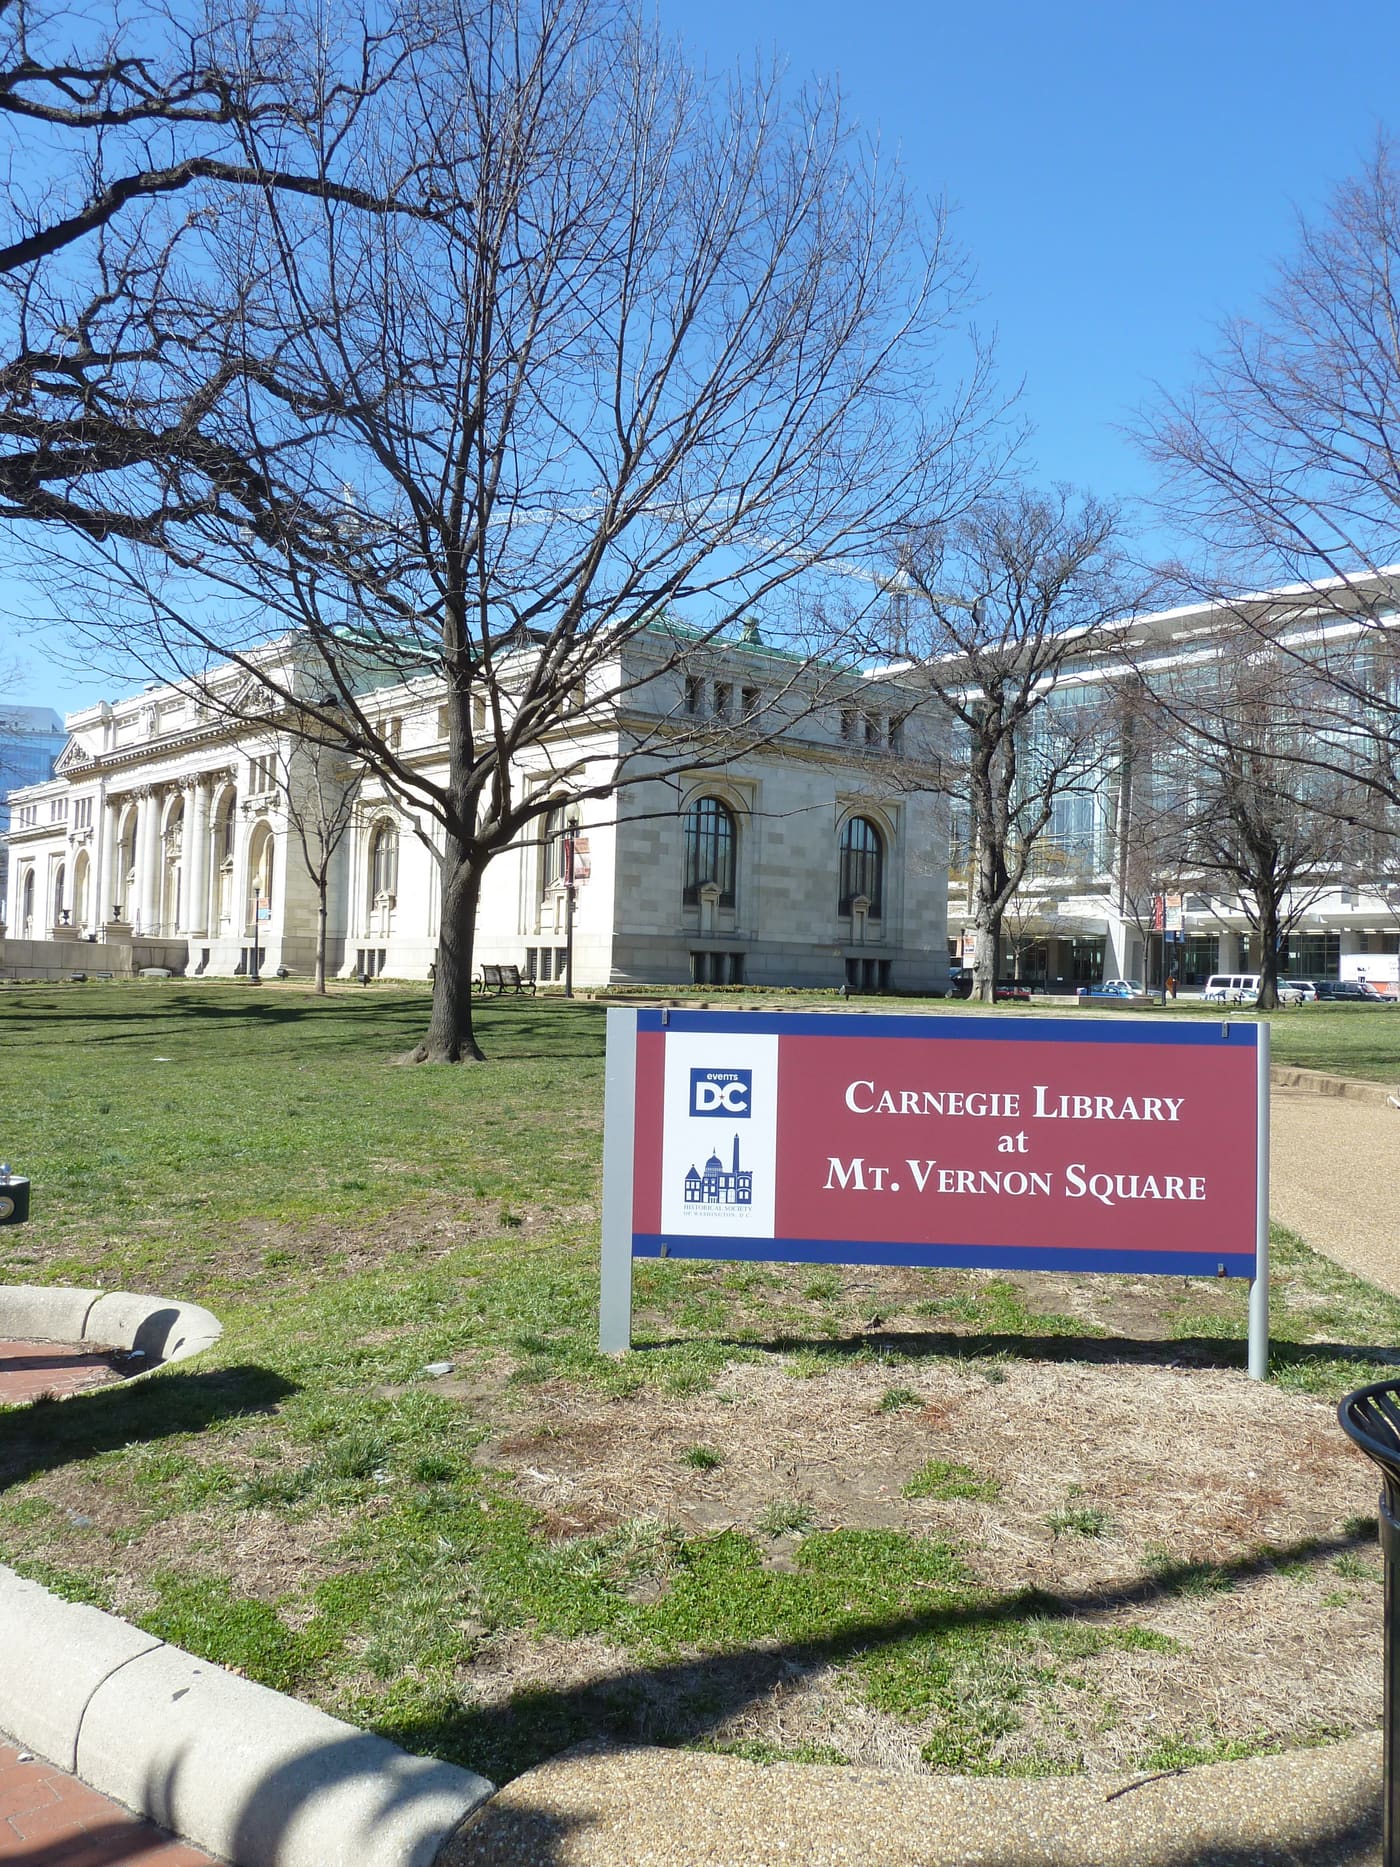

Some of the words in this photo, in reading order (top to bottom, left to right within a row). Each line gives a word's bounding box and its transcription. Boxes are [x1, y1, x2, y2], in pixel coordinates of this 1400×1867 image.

[706, 1072, 739, 1081] events
[695, 1081, 748, 1112] DC
[845, 1080, 1020, 1117] CARNEGIE
[1032, 1085, 1185, 1122] LIBRARY
[997, 1130, 1029, 1154] at
[822, 1157, 900, 1193] MT.
[905, 1159, 1054, 1196] VERNON
[1065, 1163, 1207, 1206] SQUARE
[683, 1203, 723, 1211] HISTORICAL
[724, 1204, 752, 1212] SOCIETY
